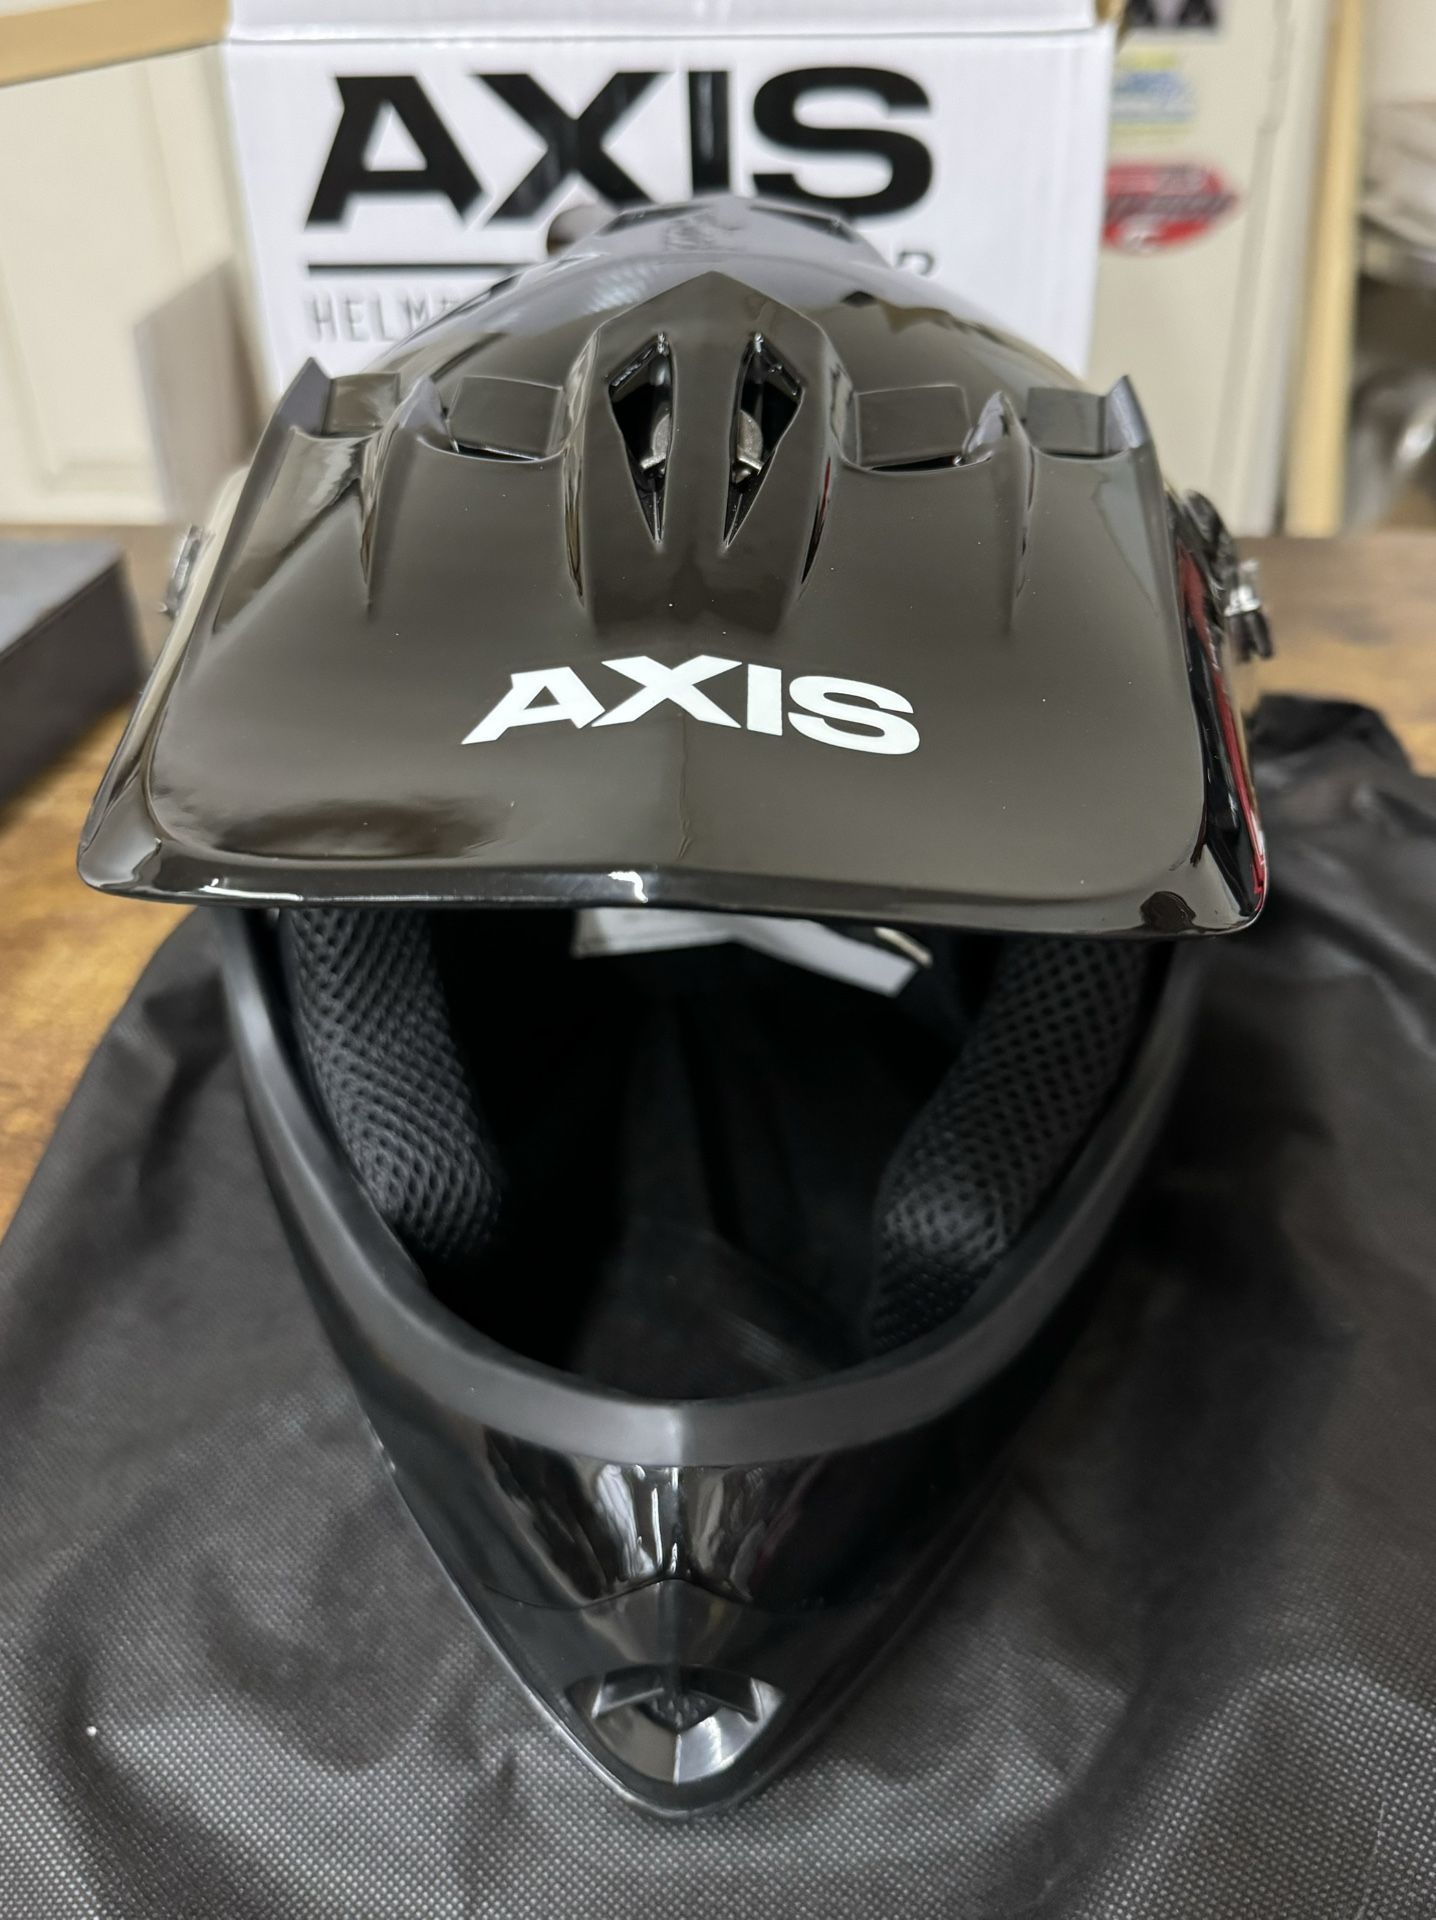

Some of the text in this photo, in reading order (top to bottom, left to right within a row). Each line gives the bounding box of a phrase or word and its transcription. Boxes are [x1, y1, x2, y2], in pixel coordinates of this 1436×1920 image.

[305, 66, 934, 227] AXIS
[311, 293, 456, 342] HELM
[461, 655, 920, 755] AXIS
